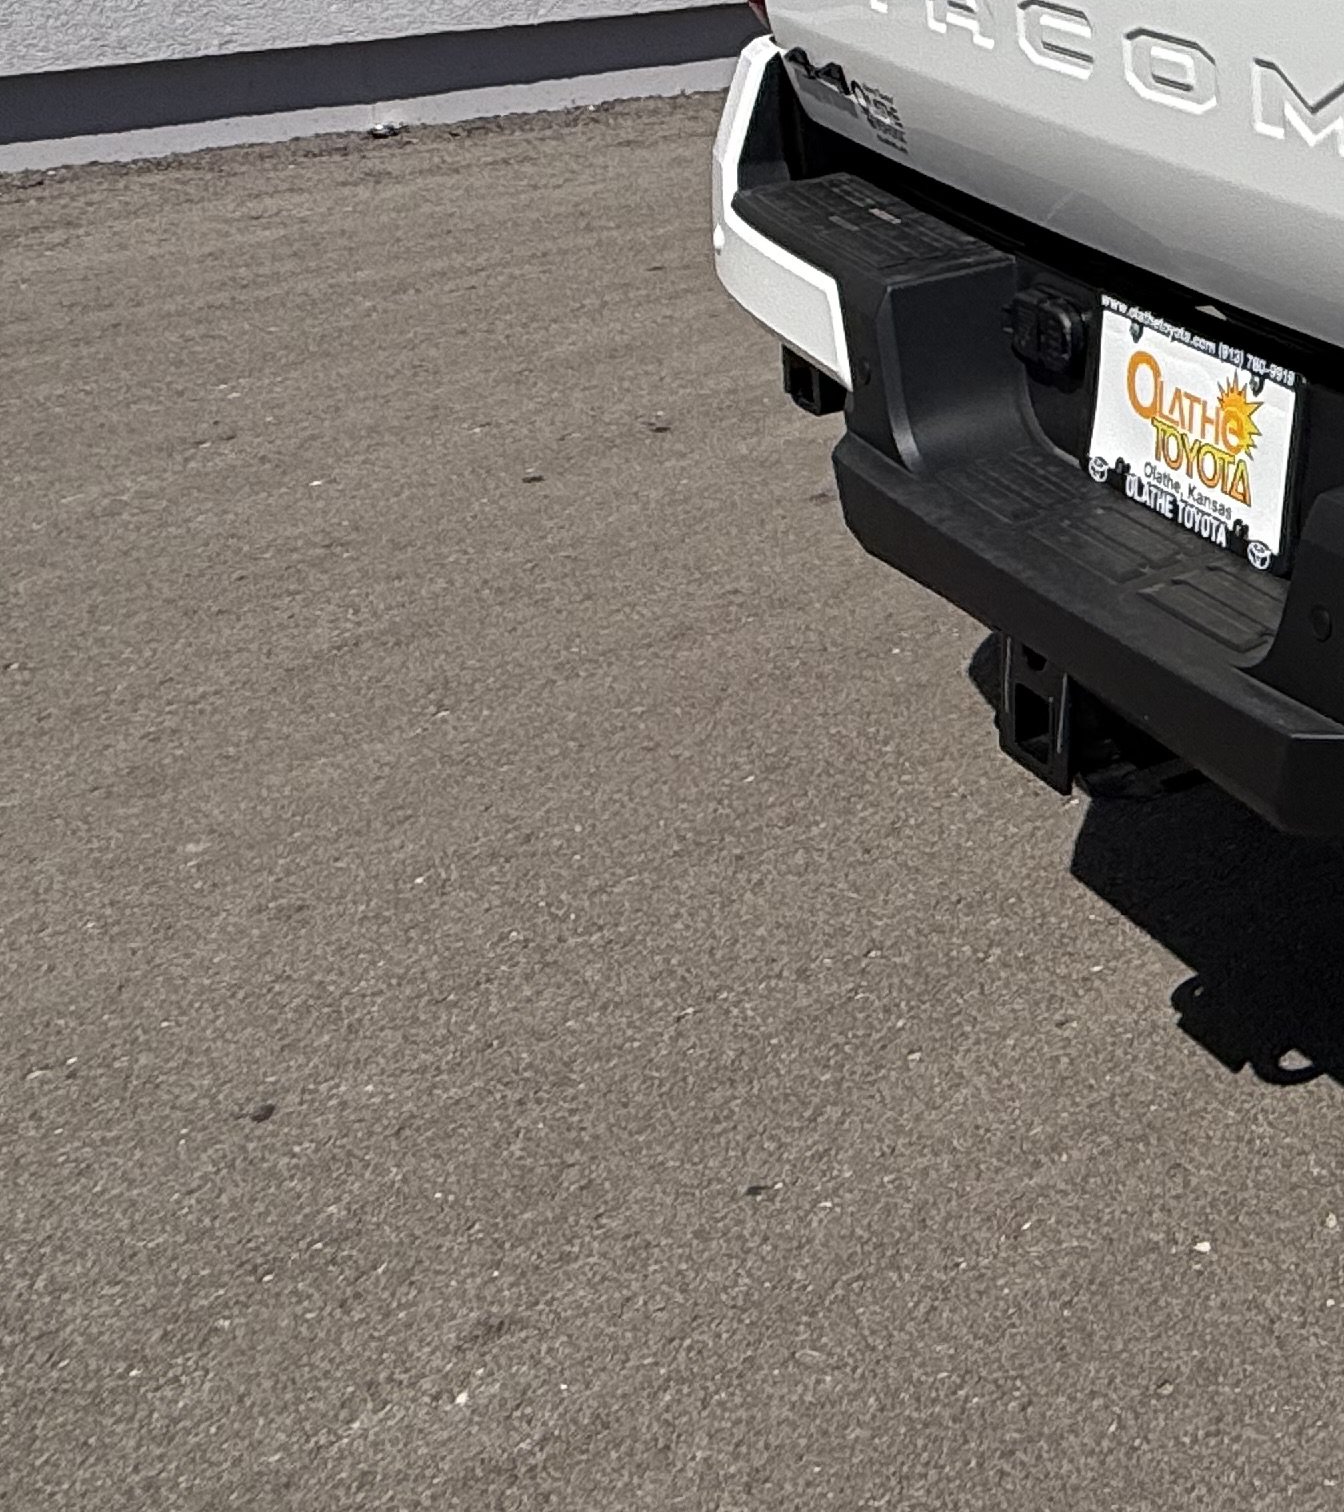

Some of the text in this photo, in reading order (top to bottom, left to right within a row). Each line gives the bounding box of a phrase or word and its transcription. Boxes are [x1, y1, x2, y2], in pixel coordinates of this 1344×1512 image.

[1218, 341, 1245, 369] (913)
[1144, 462, 1232, 520] Olathe, Kansas
[1151, 417, 1251, 507] TOYOTA
[1125, 473, 1227, 548] OLATHE TOYOTA
